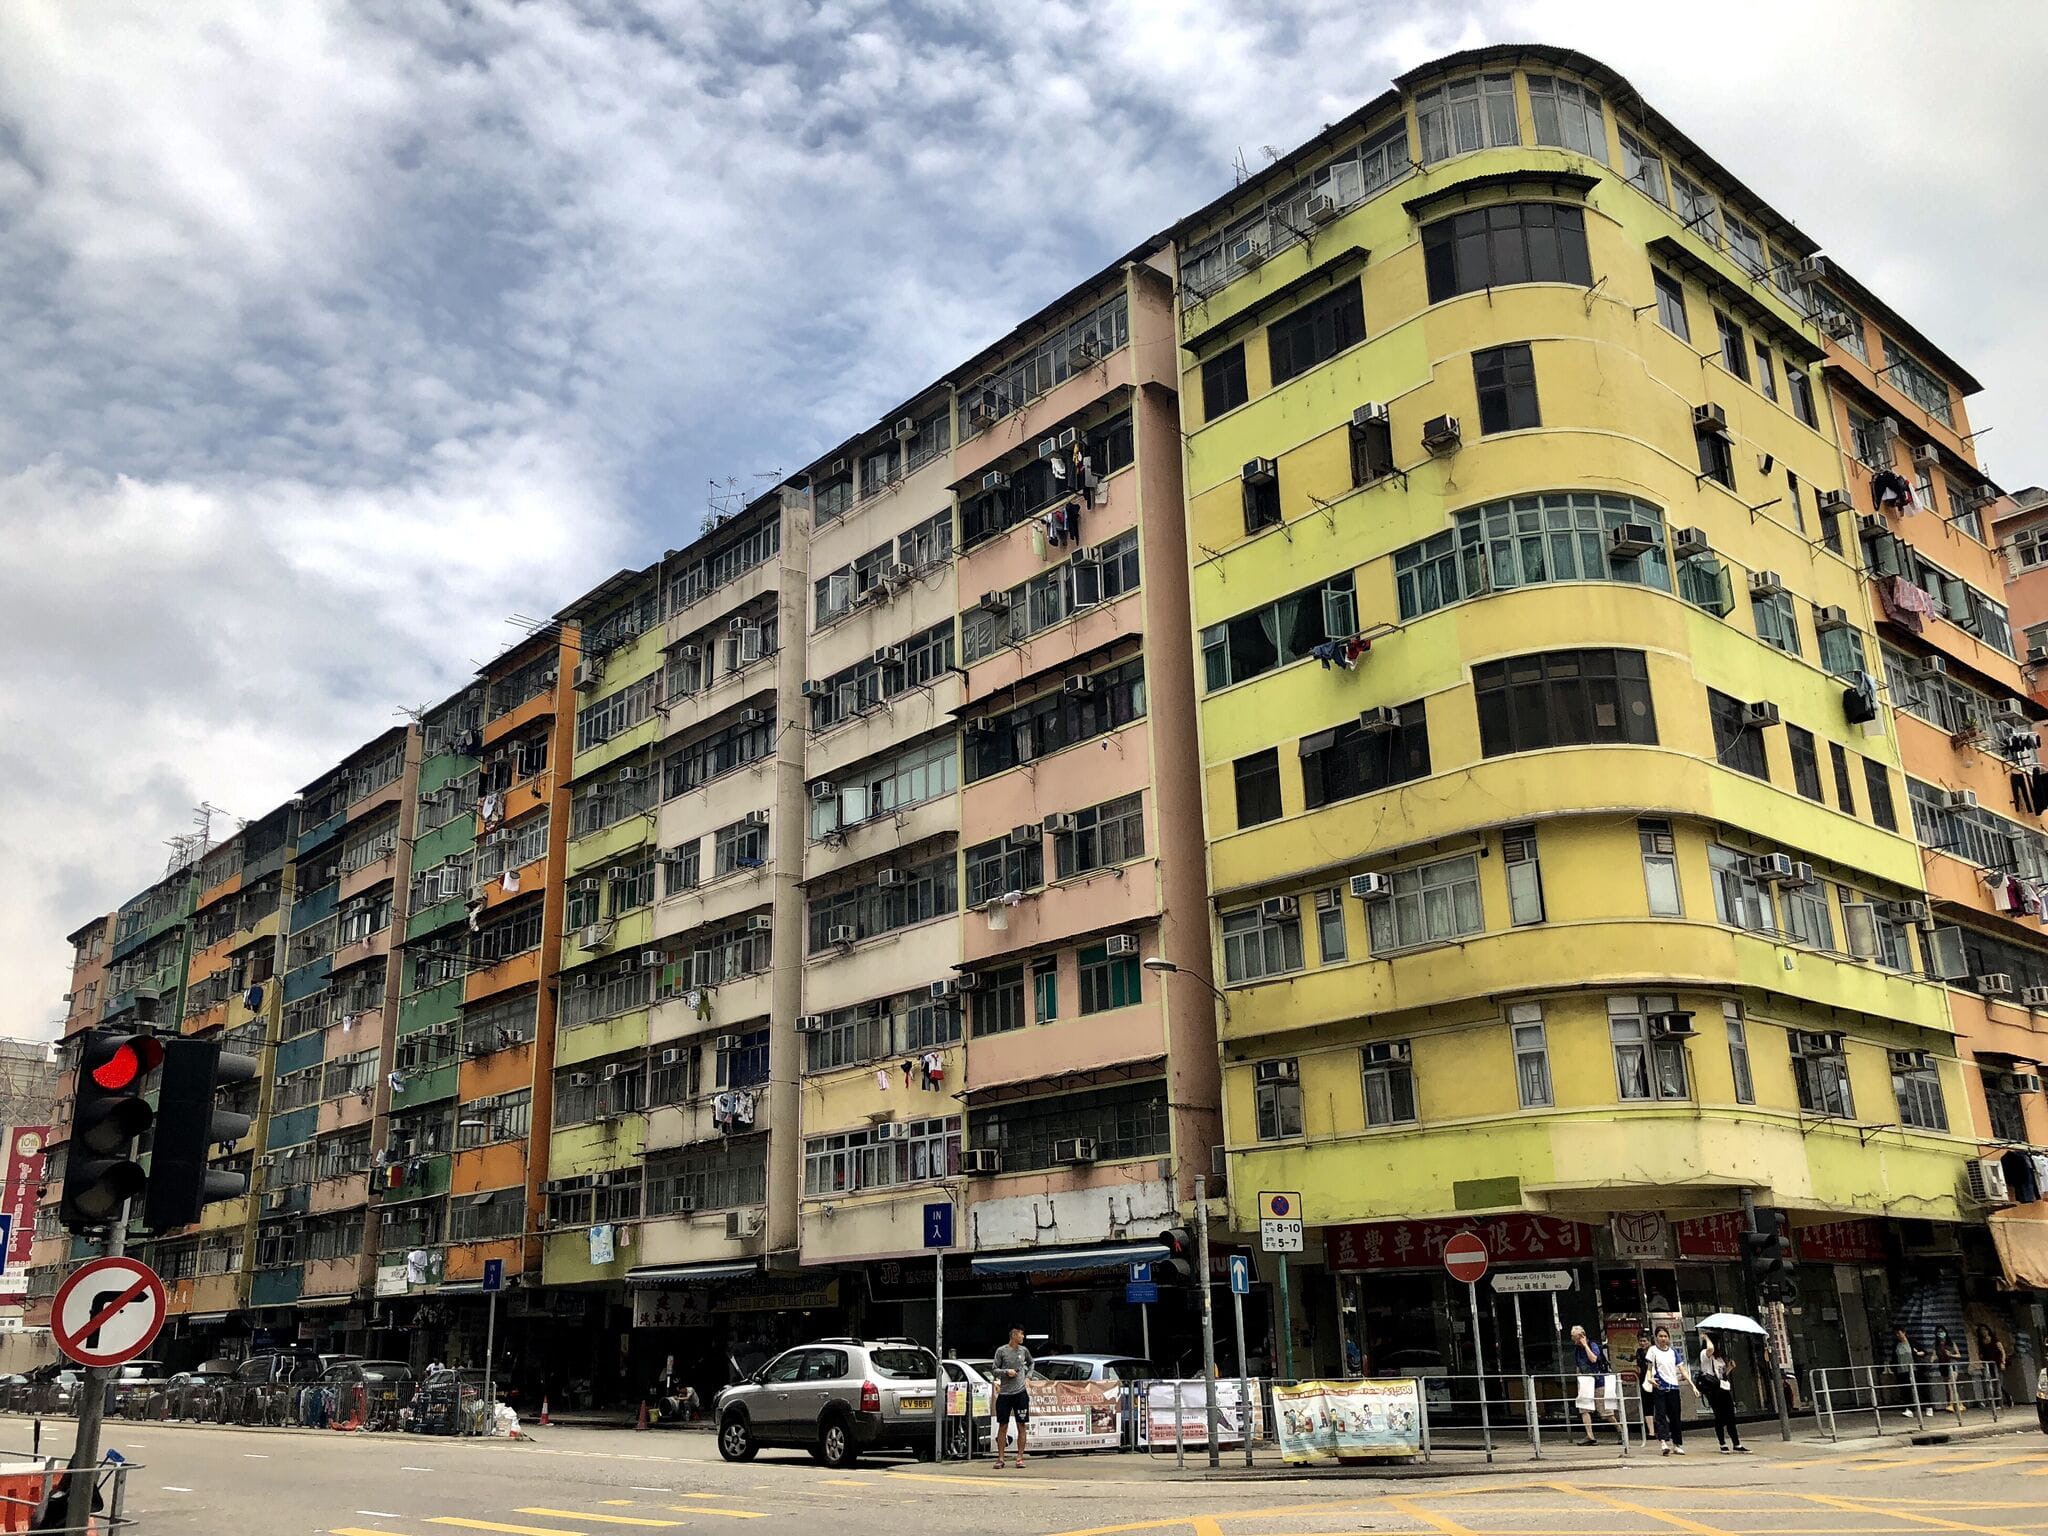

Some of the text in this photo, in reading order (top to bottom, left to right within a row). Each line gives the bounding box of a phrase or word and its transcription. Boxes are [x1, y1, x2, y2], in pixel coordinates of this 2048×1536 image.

[932, 1211, 942, 1220] IN
[932, 1224, 942, 1238] 入
[1276, 1224, 1300, 1232] 8-10
[1278, 1238, 1297, 1248] 5-7
